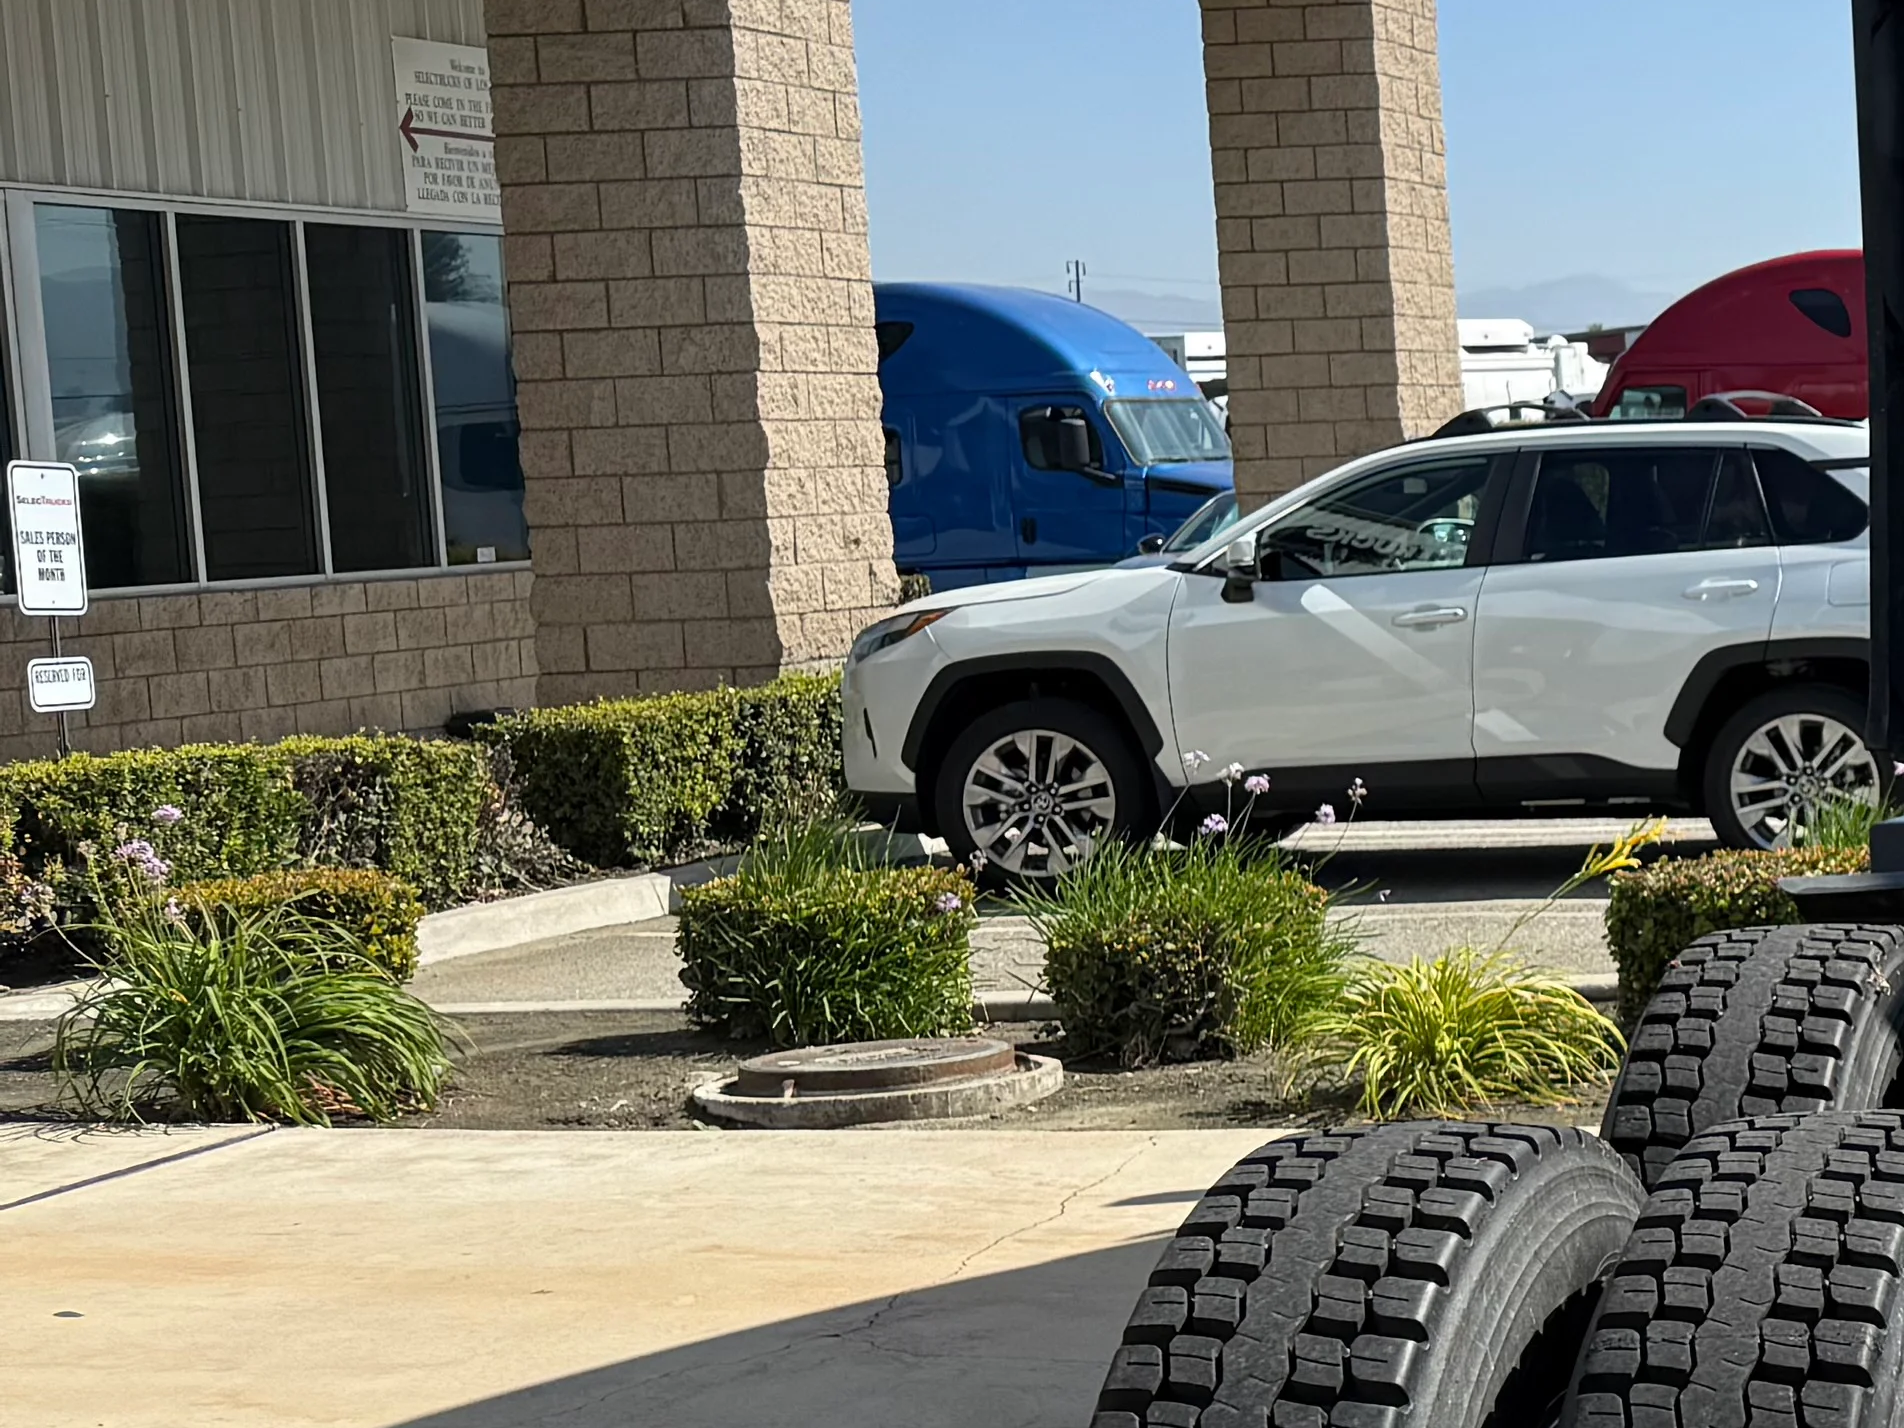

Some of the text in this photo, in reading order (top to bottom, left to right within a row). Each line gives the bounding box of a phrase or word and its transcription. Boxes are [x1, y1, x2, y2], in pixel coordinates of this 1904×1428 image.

[405, 93, 430, 108] PLEASE
[433, 96, 453, 110] COME
[456, 99, 465, 112] IN
[468, 100, 483, 113] THE
[412, 155, 431, 169] PARA
[20, 530, 76, 545] SALES PERSON
[37, 550, 63, 563] OF THE
[38, 568, 65, 581] MONTH
